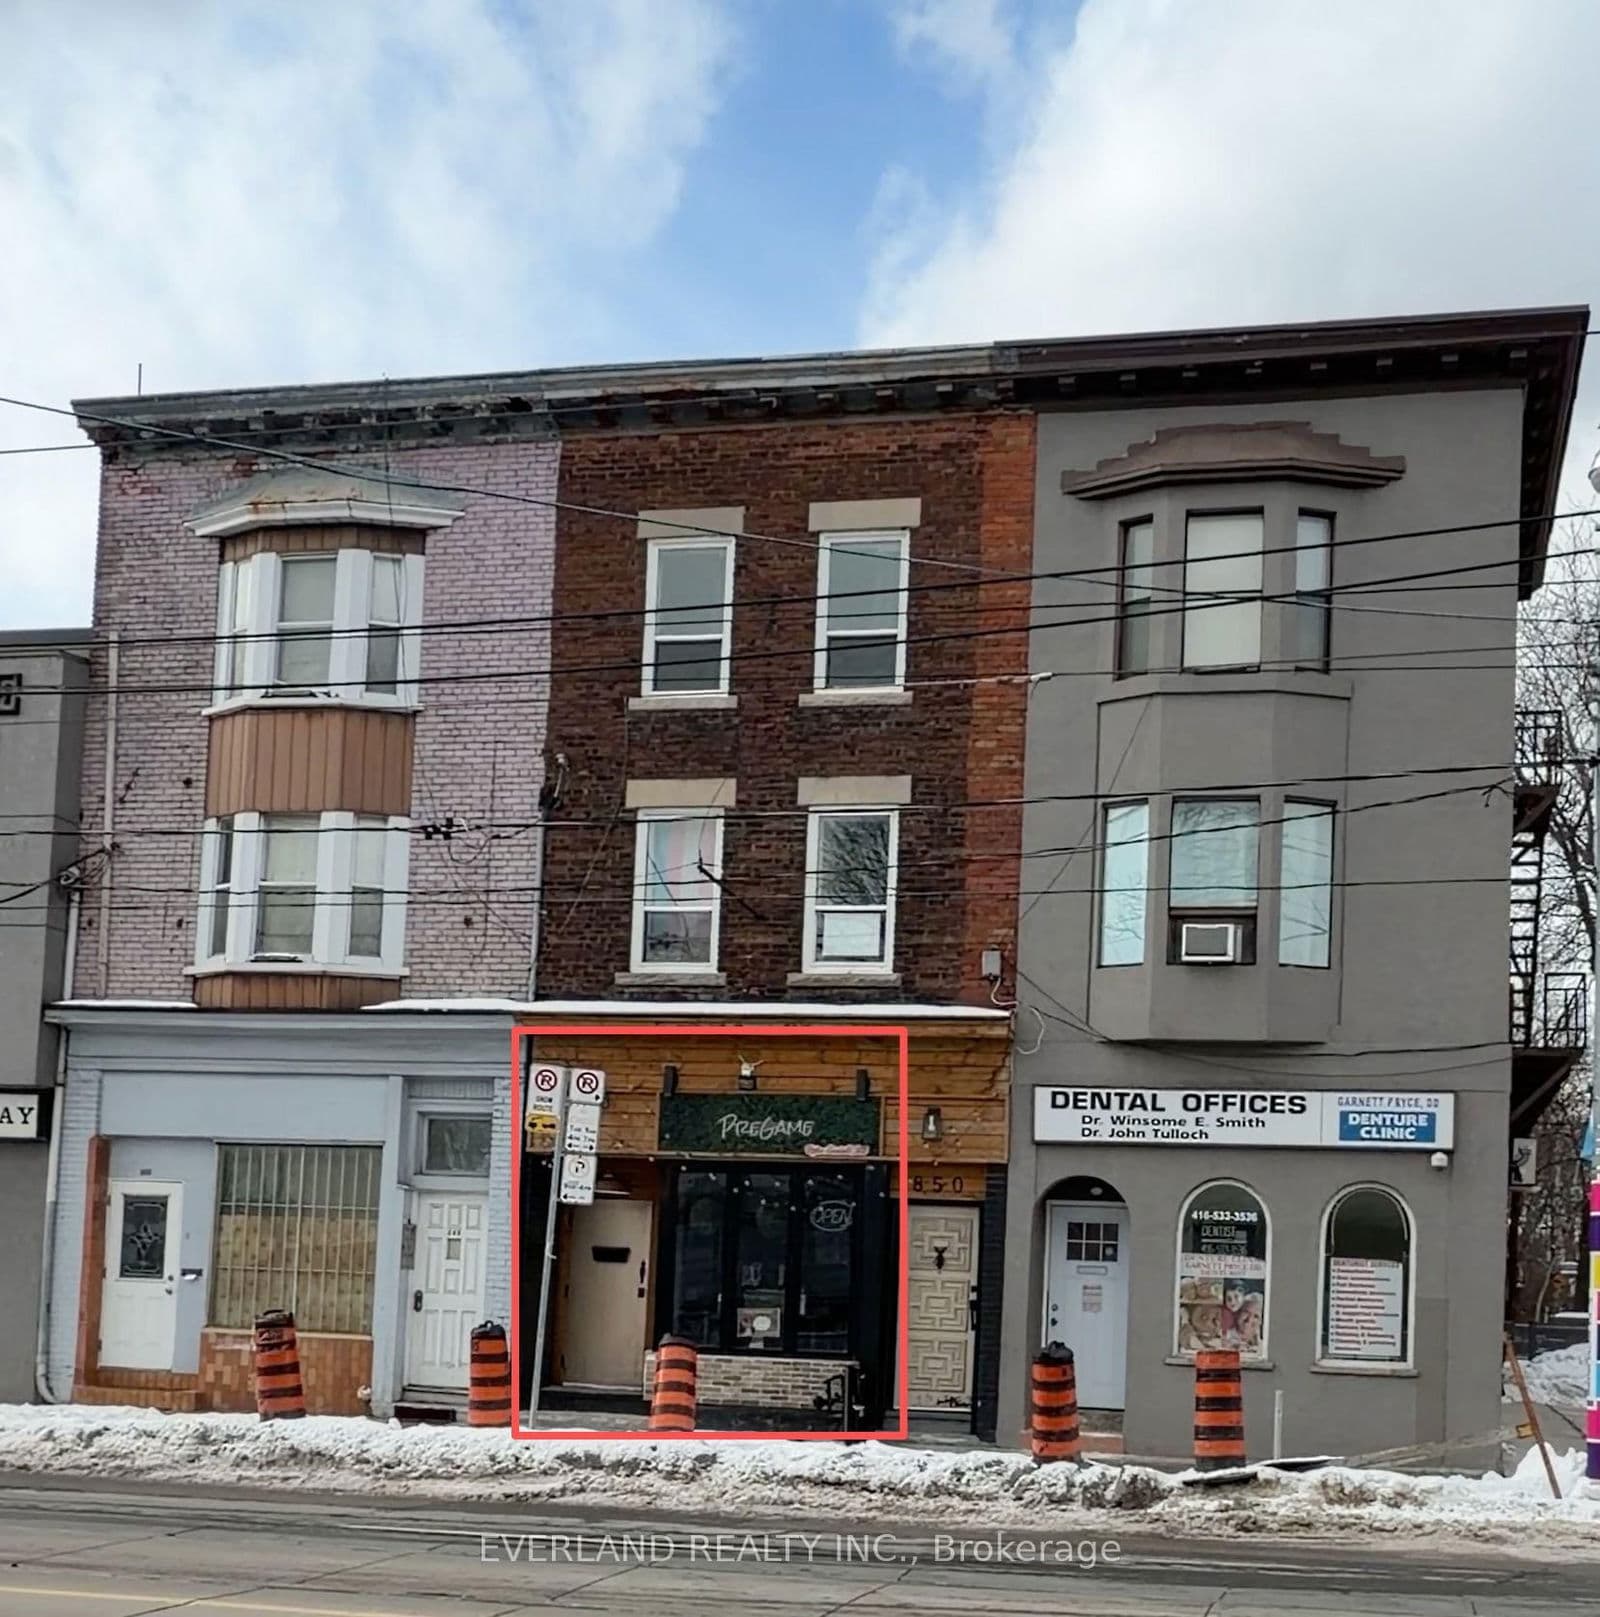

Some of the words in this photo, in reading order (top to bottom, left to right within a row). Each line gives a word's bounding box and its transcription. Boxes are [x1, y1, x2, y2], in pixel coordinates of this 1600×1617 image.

[1050, 1090, 1166, 1111] DENTAL
[1181, 1092, 1307, 1115] OFFICES
[1081, 1115, 1103, 1125] Dr.
[1110, 1115, 1187, 1127] Winsome
[1215, 1116, 1266, 1129] Smith
[1347, 1112, 1429, 1127] DENTURE
[1081, 1127, 1103, 1139] Dr.
[1108, 1127, 1146, 1140] John
[1151, 1127, 1210, 1141] Tulloch
[1359, 1126, 1417, 1140] CLINIC
[912, 1175, 964, 1193] 850
[814, 1206, 854, 1226] OPEN
